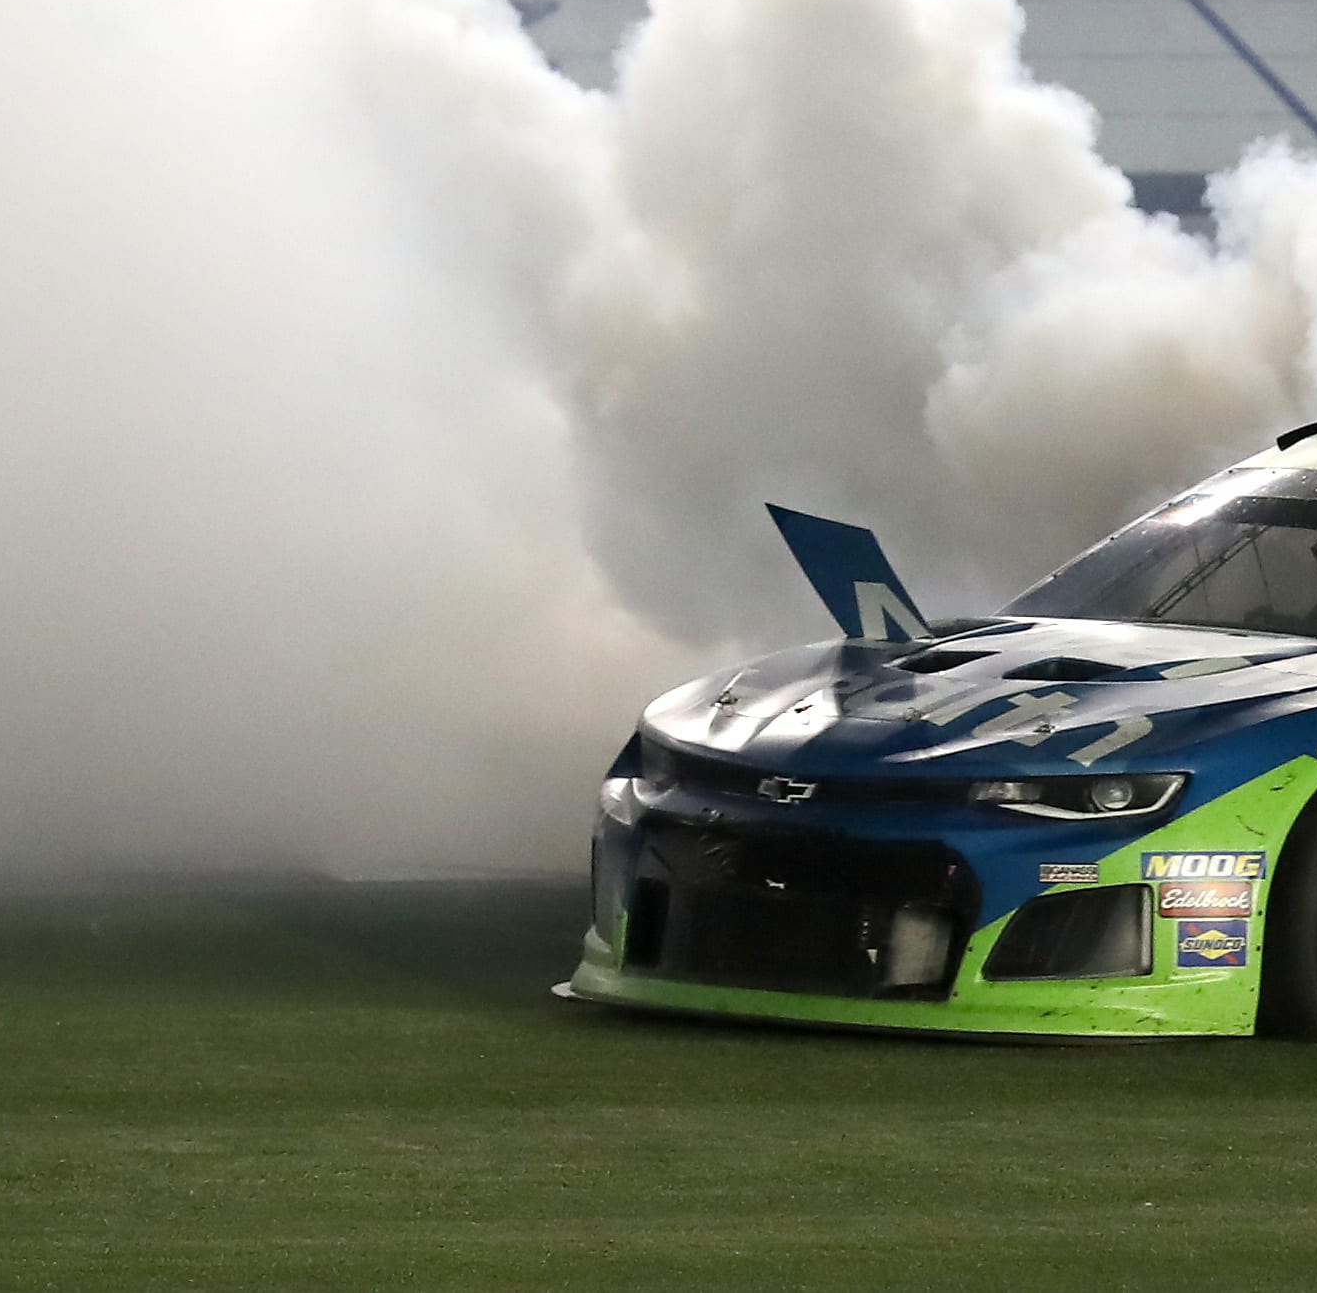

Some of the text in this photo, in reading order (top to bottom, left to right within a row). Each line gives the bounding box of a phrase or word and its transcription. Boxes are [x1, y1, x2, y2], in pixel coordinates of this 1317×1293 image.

[1145, 854, 1262, 878] MOOG
[1161, 888, 1249, 910] Edelbrock
[1183, 938, 1243, 951] SUNOCO
